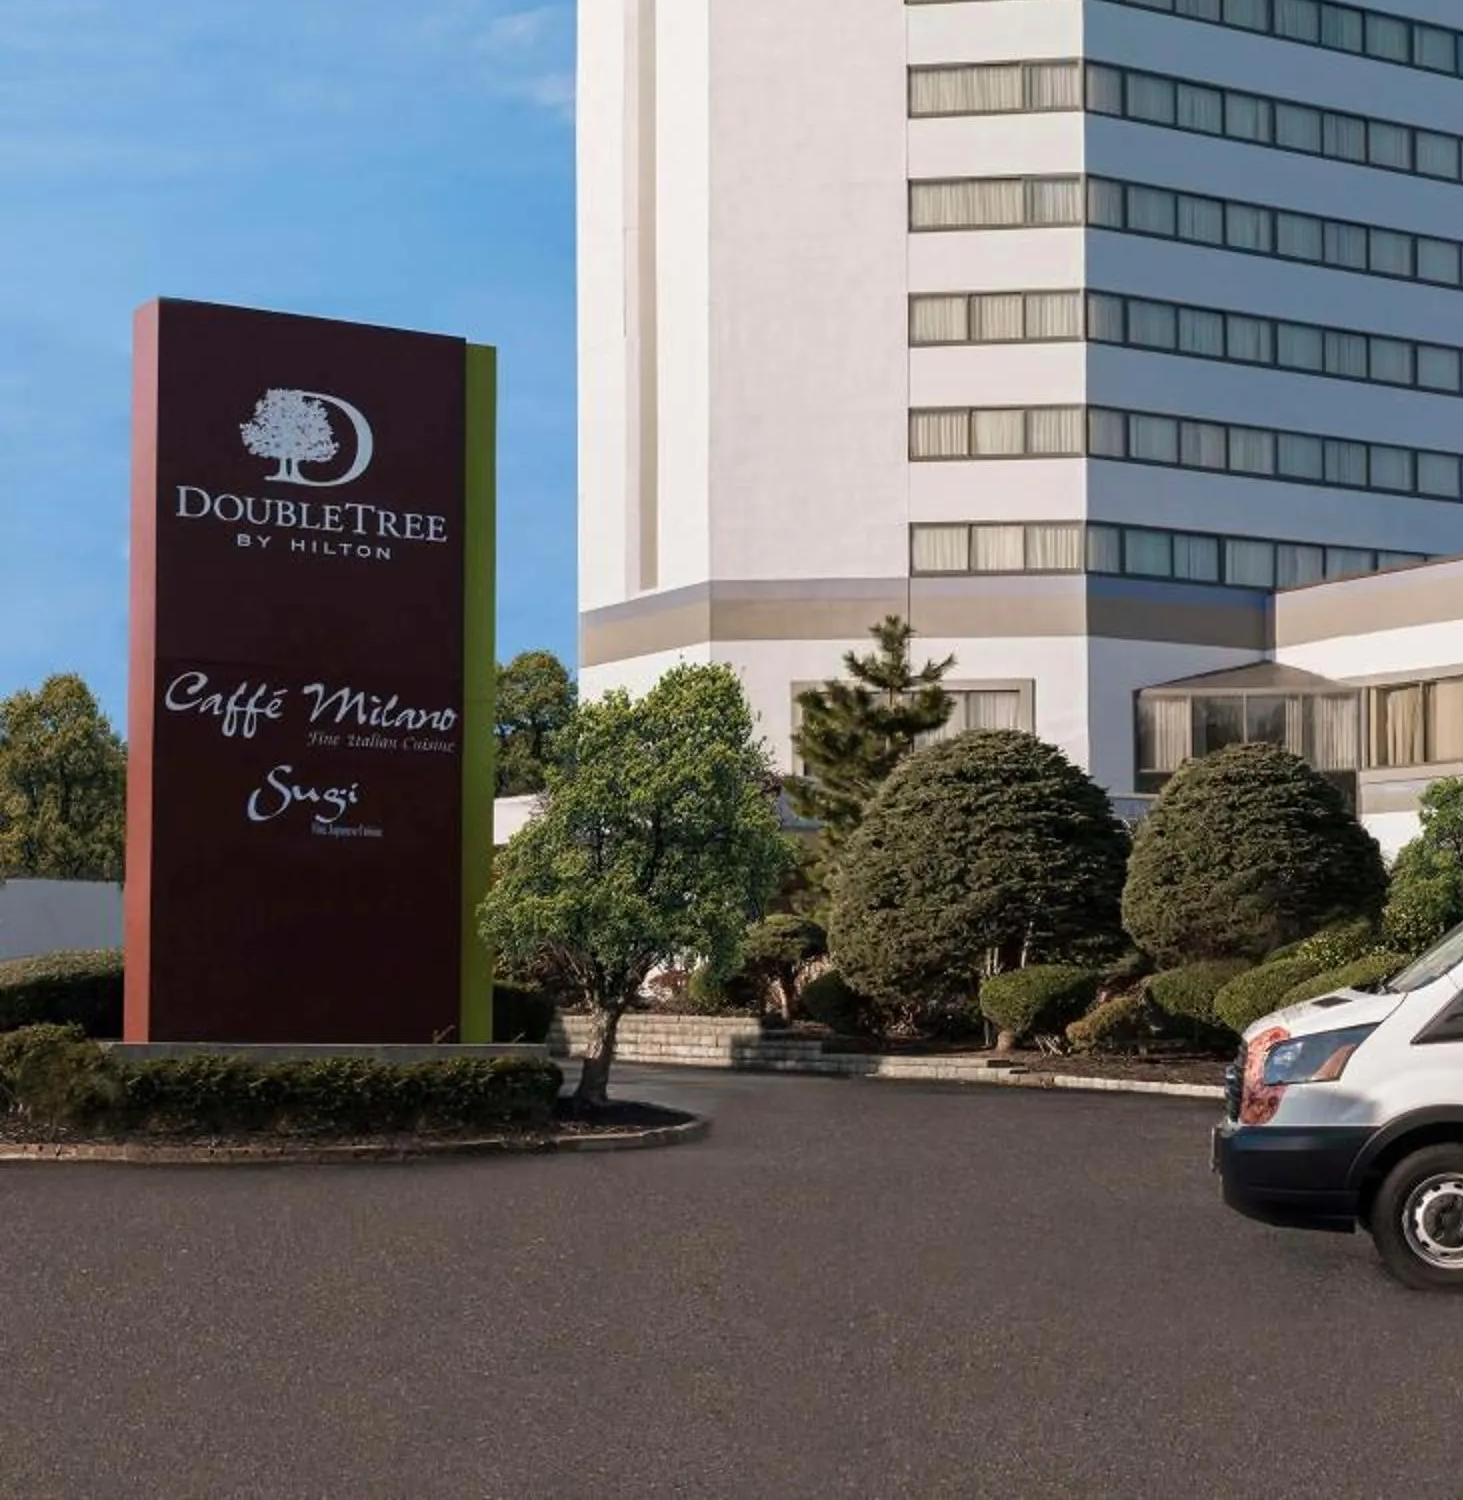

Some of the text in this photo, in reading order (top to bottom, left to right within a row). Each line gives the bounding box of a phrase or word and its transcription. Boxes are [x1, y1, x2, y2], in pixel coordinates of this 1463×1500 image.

[175, 484, 449, 543] DOUBLETREE
[237, 533, 392, 560] BY HILTON
[164, 670, 458, 739] Caffé Milano
[247, 764, 359, 823] Sugi
